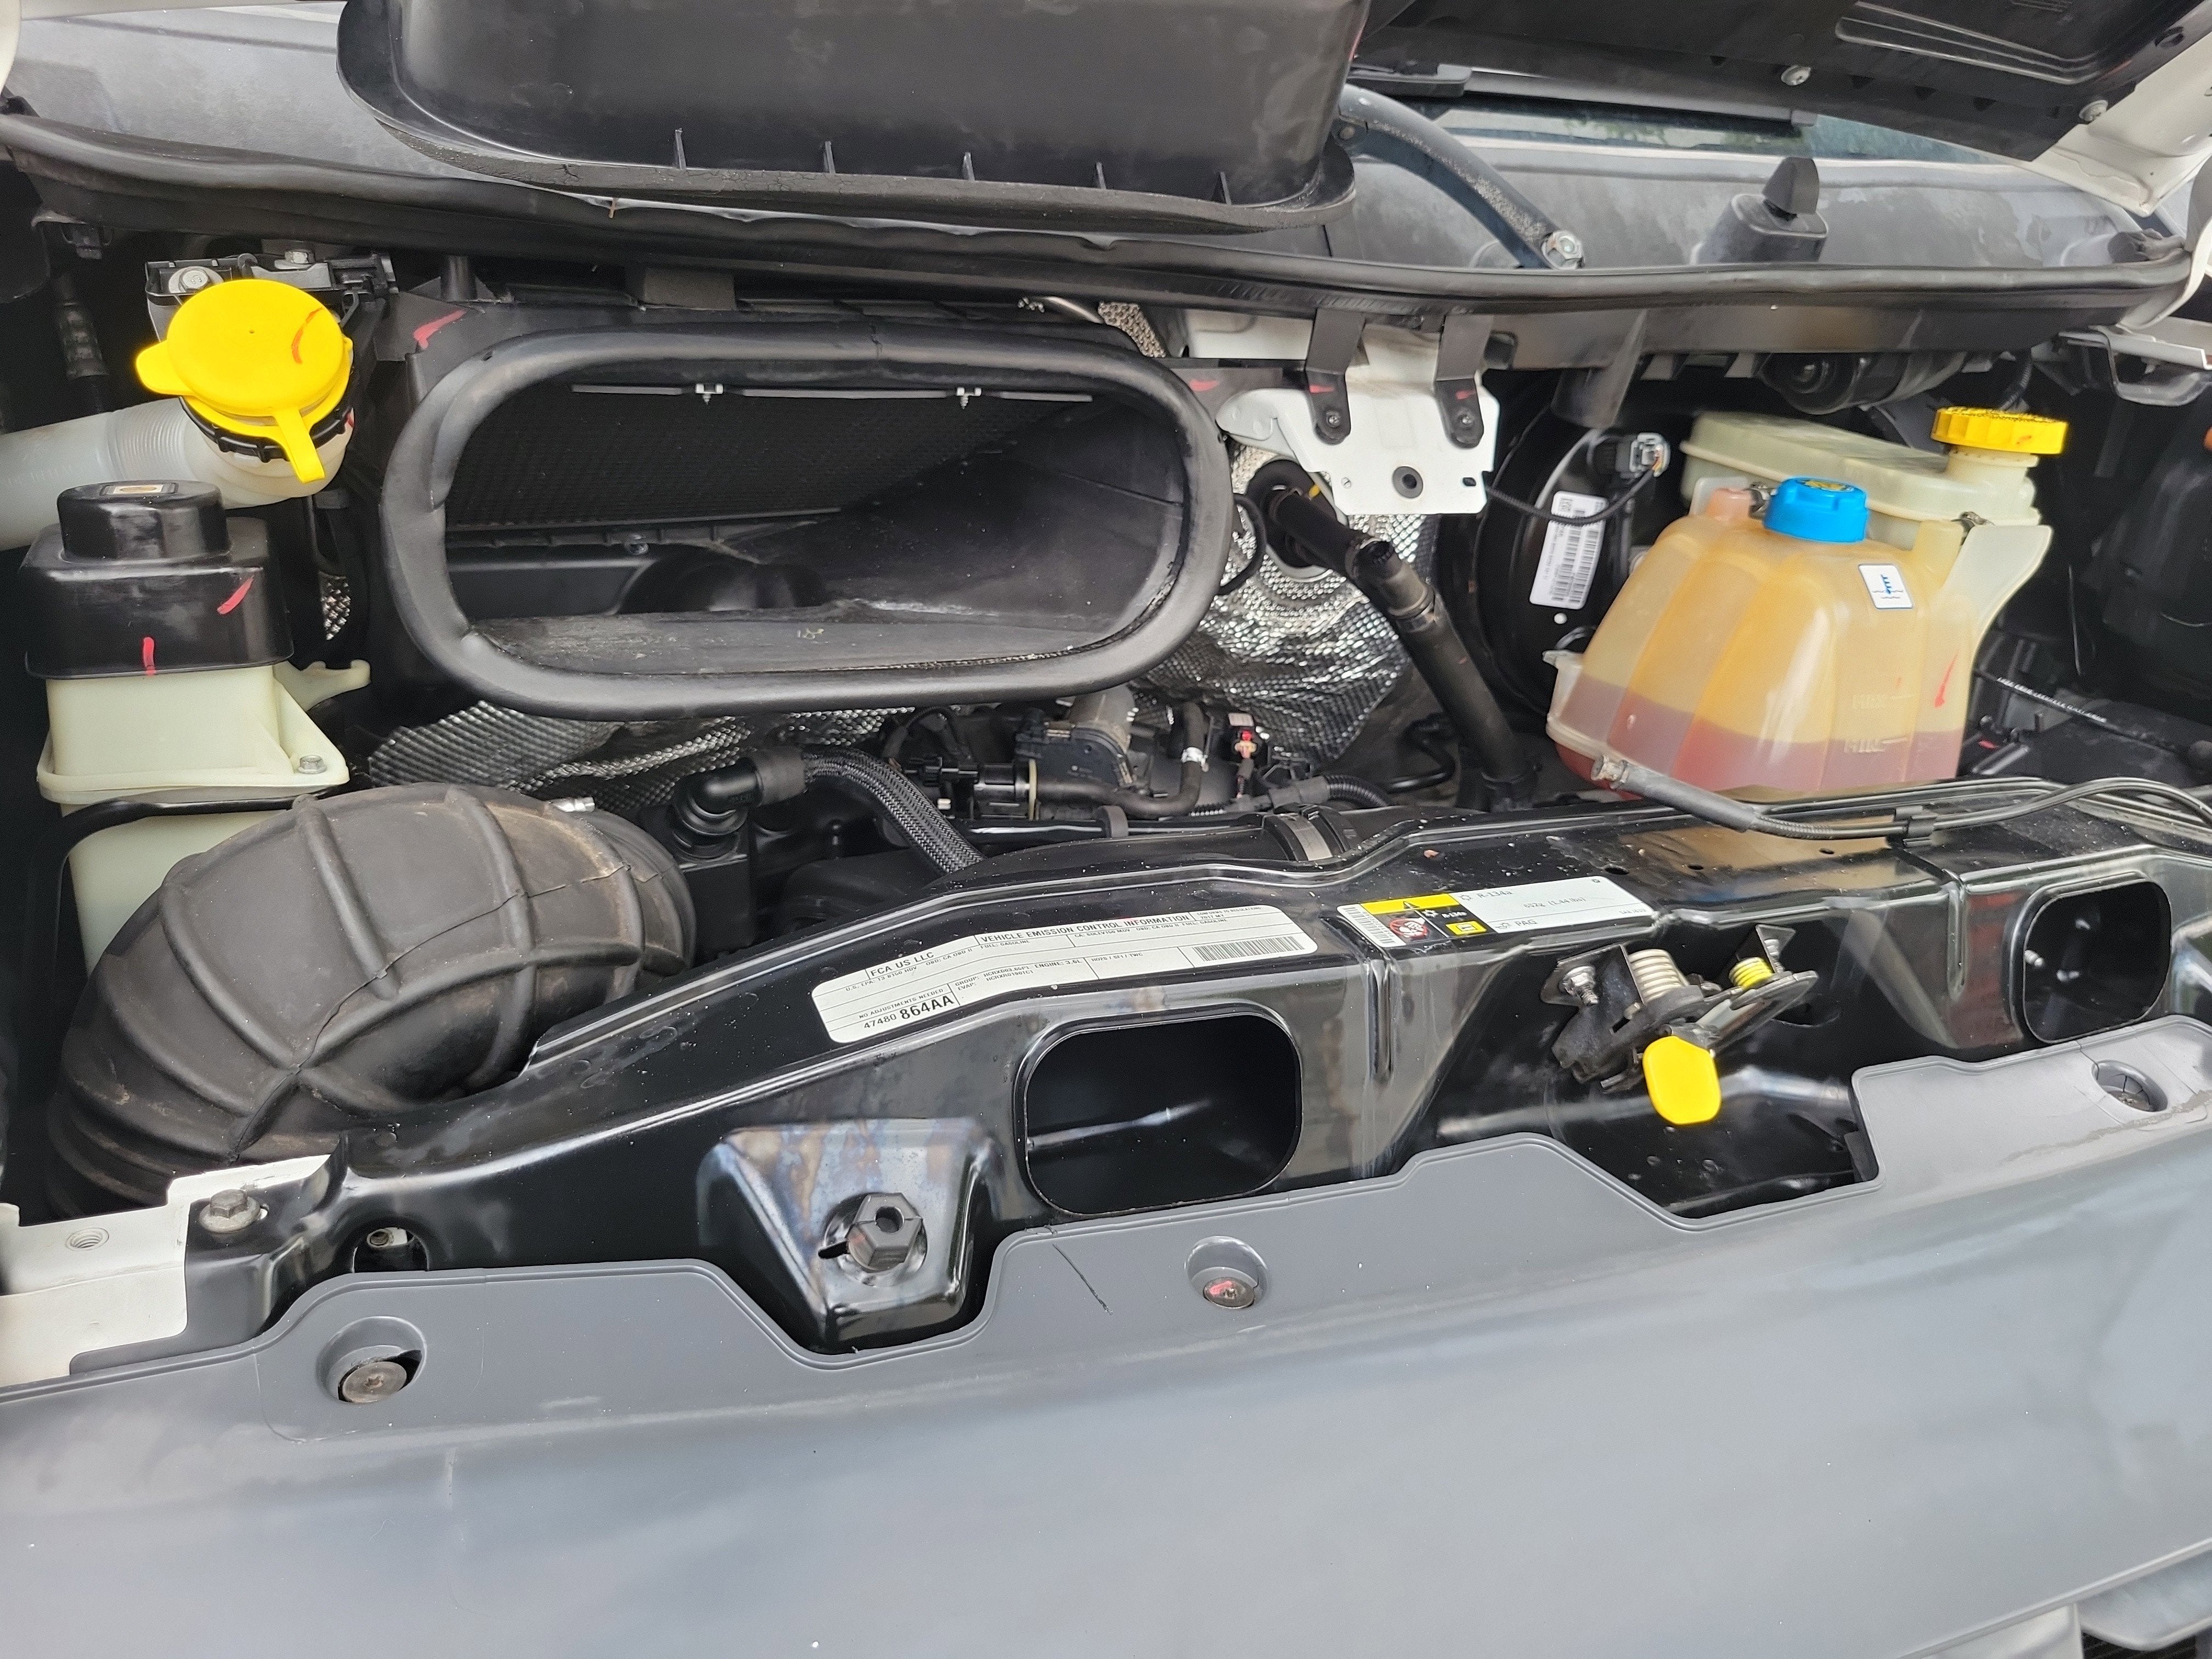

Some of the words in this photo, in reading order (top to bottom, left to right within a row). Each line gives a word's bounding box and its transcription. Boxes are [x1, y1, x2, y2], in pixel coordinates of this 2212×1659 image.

[980, 933, 1024, 943] VEHICLE
[1026, 927, 1074, 937] EMISSION
[1076, 922, 1122, 932] CONTROL
[1124, 915, 1190, 926] INFORMATION
[871, 966, 893, 977] FCA
[896, 960, 911, 969] US
[914, 952, 934, 963] LLC
[955, 975, 980, 987] GROUP:
[1035, 961, 1064, 969] ENGINE:
[958, 982, 977, 991] EVAP:
[864, 1013, 897, 1029] 47480
[899, 995, 955, 1020] 864AA
[871, 998, 917, 1016] ADJUSTMENTS
[918, 989, 944, 1000] NEEDED
